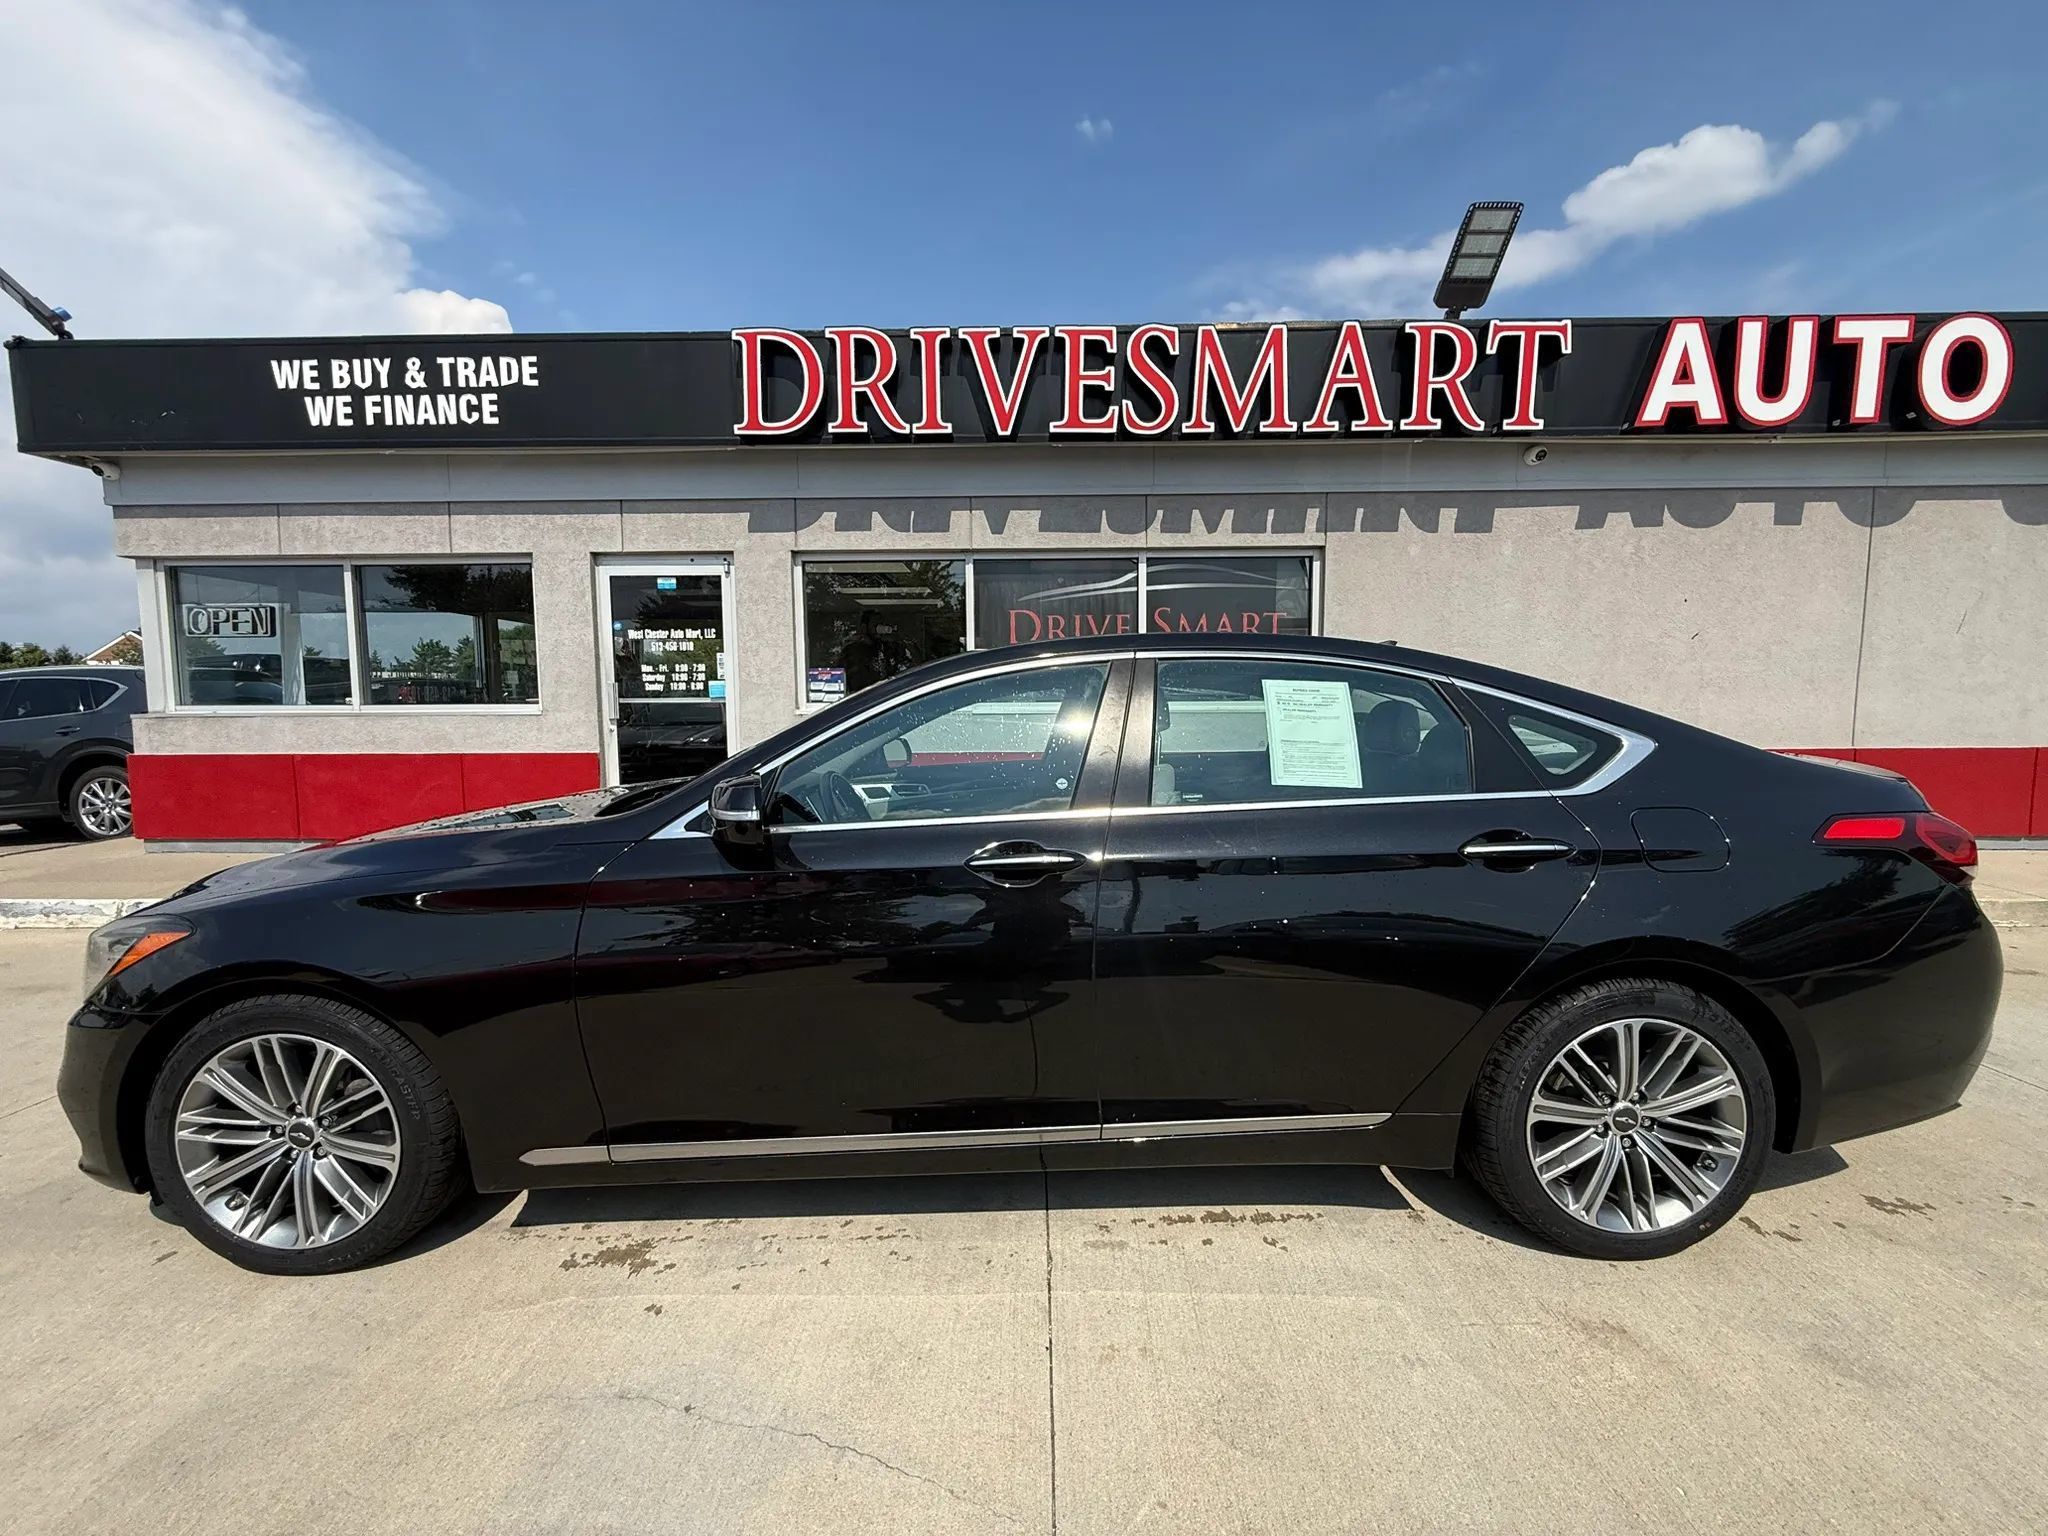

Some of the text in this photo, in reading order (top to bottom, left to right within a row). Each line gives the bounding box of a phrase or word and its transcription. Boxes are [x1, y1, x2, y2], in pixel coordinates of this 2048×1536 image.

[270, 355, 539, 390] WE BUY & TRADE
[731, 311, 2014, 436] DRIVESMART AUTO
[303, 393, 500, 427] WE FINANCE
[189, 607, 271, 635] OPEN
[627, 628, 716, 640] West Chester Auto Mart, LLC
[641, 673, 666, 683] Saturday
[644, 682, 664, 692] Sunday
